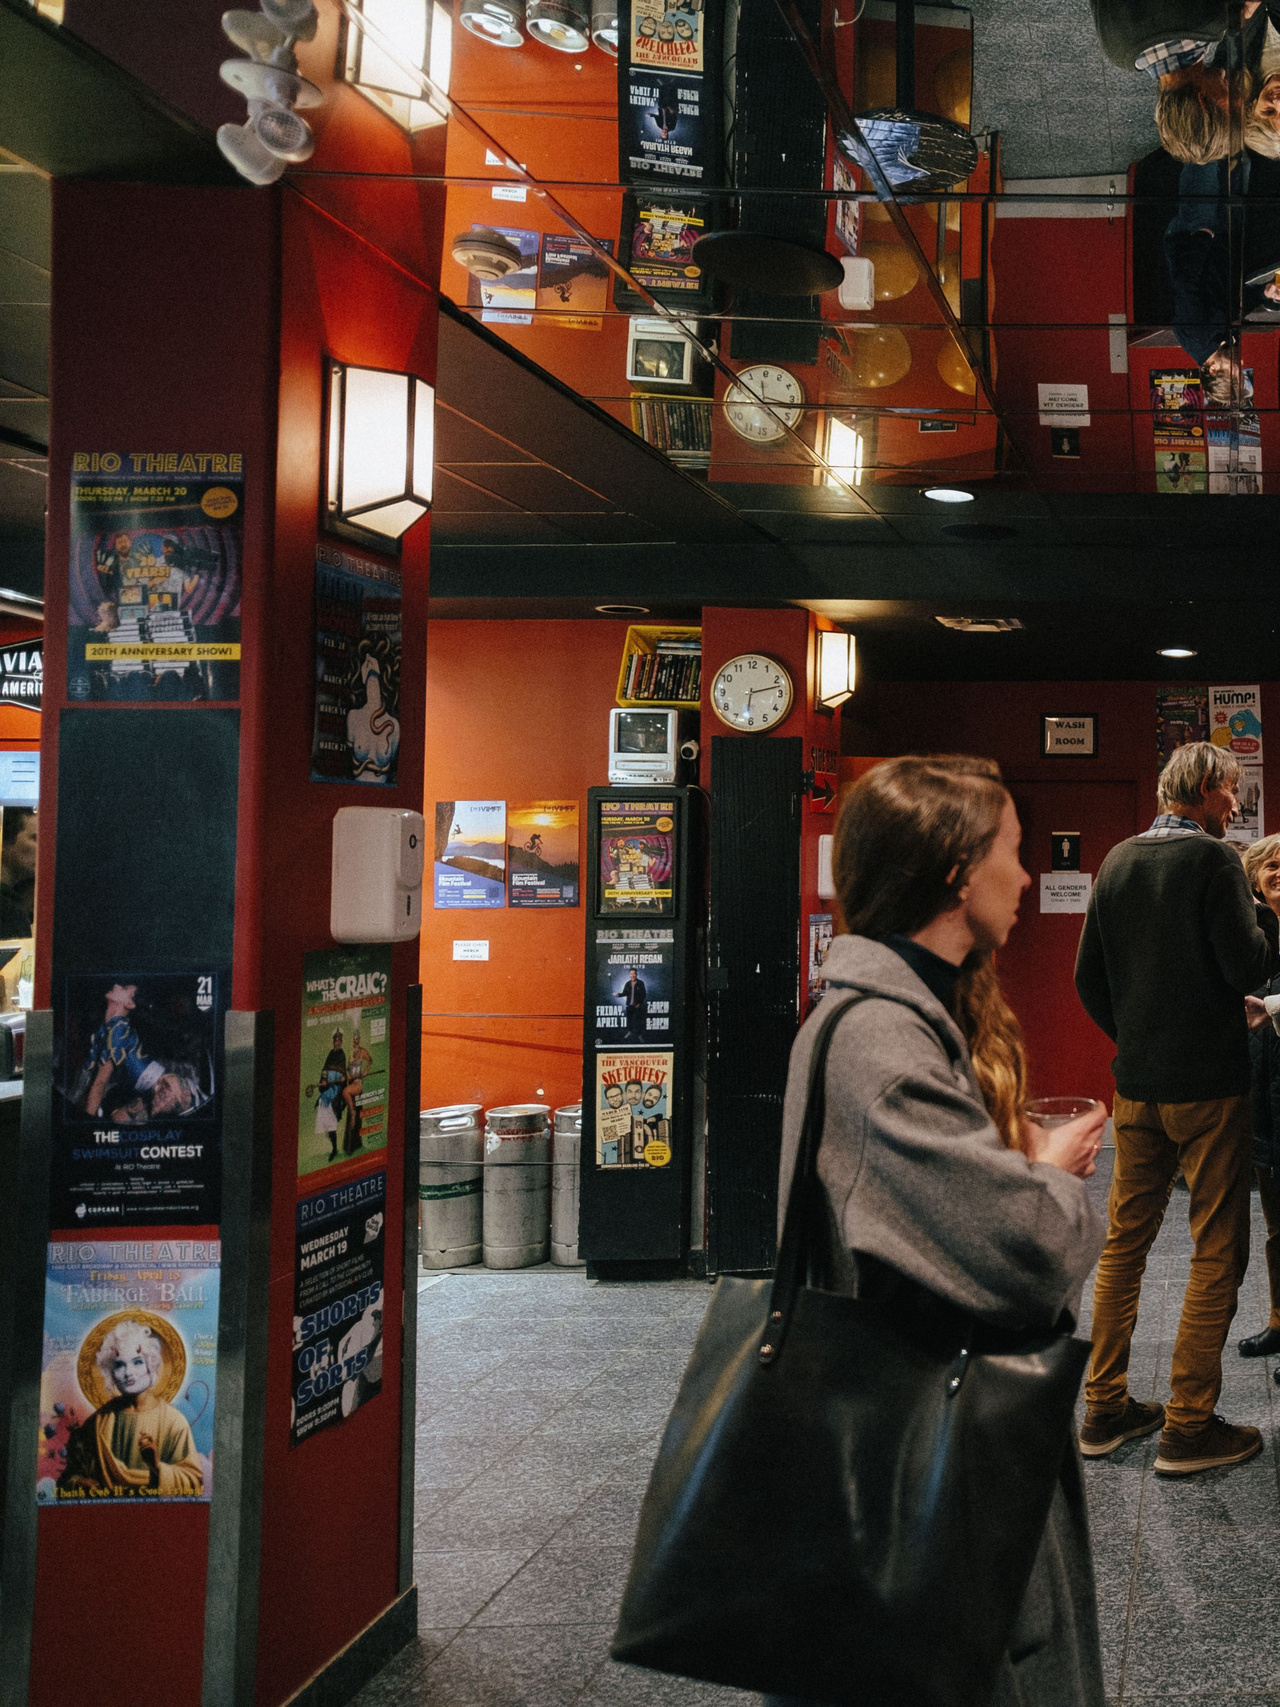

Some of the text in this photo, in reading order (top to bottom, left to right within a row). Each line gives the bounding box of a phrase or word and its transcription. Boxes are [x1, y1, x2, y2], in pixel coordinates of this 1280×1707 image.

[73, 453, 242, 473] RIO THEATRE
[134, 487, 171, 496] MARCH
[174, 487, 187, 496] 20
[91, 647, 232, 656] 20TH ANNIVERSARY SHOW!
[734, 665, 743, 673] 11
[748, 661, 758, 670] 12
[765, 665, 769, 673] 1
[723, 674, 733, 683] 10
[774, 675, 780, 684] 2
[720, 689, 726, 697] 9
[778, 690, 783, 698] 3
[1213, 692, 1256, 705] HUMP!
[723, 703, 729, 711] 8
[773, 704, 779, 712] 4
[733, 713, 739, 721] 7
[748, 718, 754, 726] 6
[763, 714, 768, 722] 5
[1055, 722, 1086, 730] WASH
[1055, 738, 1085, 746] ROOM
[597, 929, 673, 939] RIO THEATRE
[608, 954, 663, 964] JARLATH REGAN
[197, 976, 213, 994] 21
[306, 972, 388, 999] WHAT'S CRAIC?
[196, 995, 213, 1006] MAR
[322, 991, 337, 1002] THE
[596, 1006, 625, 1016] FRIDAY,
[596, 1017, 627, 1028] APRIL 11
[601, 1066, 668, 1086] SKETCHFEST
[93, 1131, 120, 1143] THE
[140, 1146, 203, 1159] CONTEST
[302, 1199, 326, 1220] RIO
[331, 1176, 383, 1208] THEATRE
[301, 1226, 349, 1255] WEDNESDAY
[51, 1242, 219, 1263] RIO THEATRE
[301, 1240, 348, 1271] MARCH 19
[137, 1270, 163, 1280] April
[60, 1283, 208, 1303] FABERGE BALL
[300, 1281, 381, 1342] SHORTS
[298, 1338, 330, 1373] OF
[297, 1347, 368, 1407] SORTS
[296, 1409, 317, 1427] DOORS
[296, 1422, 314, 1437] SHOW
